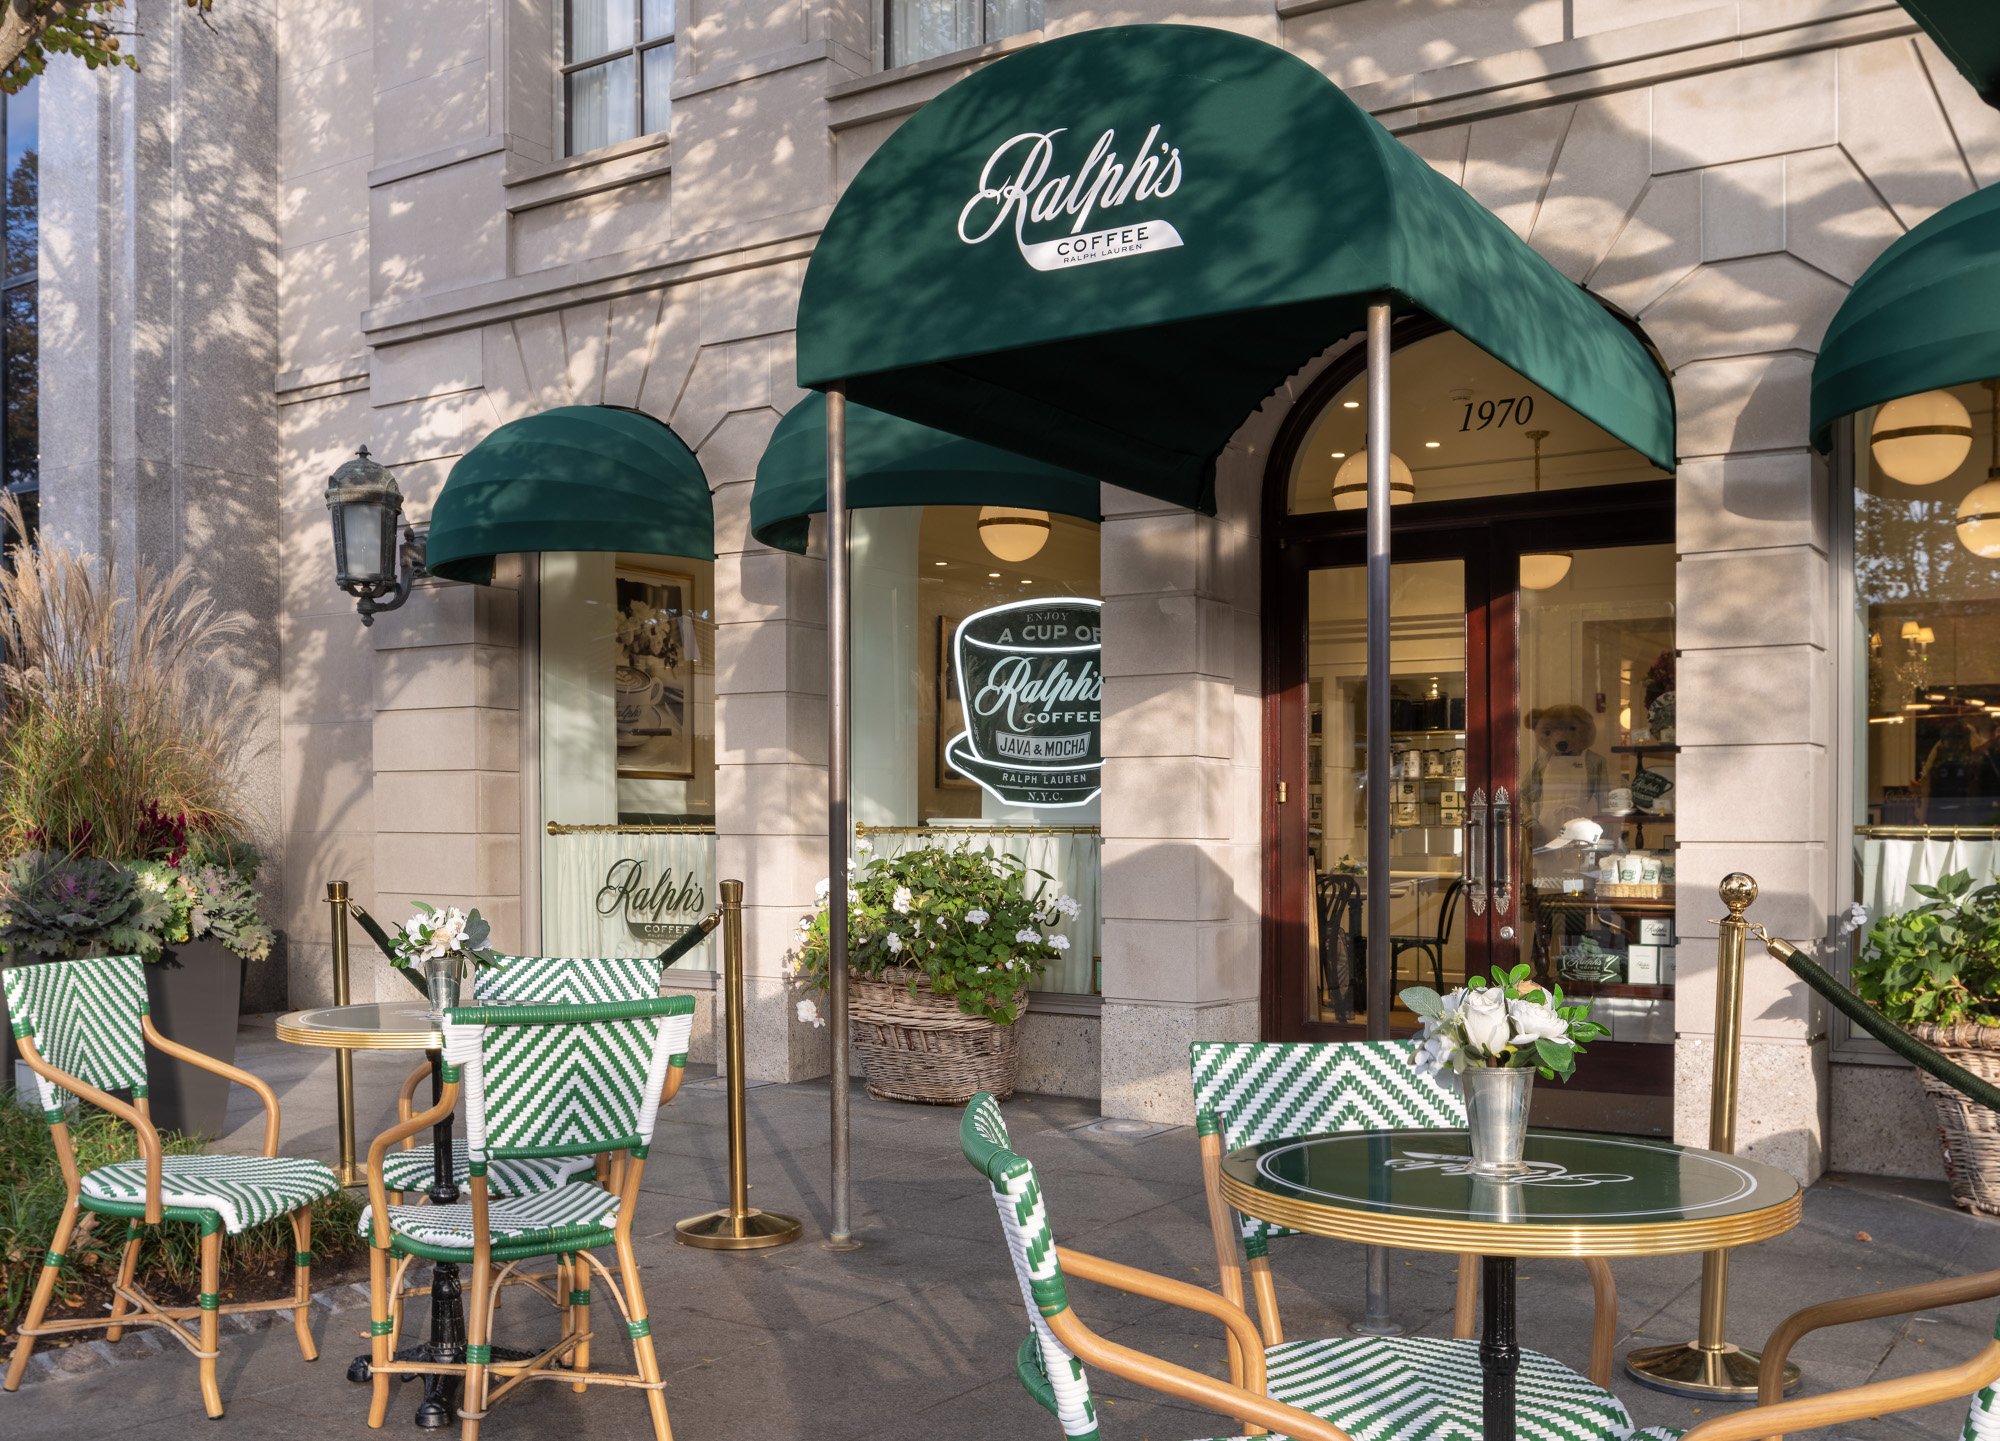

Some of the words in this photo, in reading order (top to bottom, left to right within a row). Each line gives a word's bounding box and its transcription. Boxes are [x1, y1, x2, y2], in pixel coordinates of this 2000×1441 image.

[957, 123, 1183, 248] Ralph's
[1057, 226, 1149, 256] COFFEE
[1063, 252, 1097, 264] RALPH
[1101, 243, 1143, 257] LAUREN
[1458, 395, 1534, 433] 1970
[1026, 611, 1069, 623] ENJOY
[996, 627, 1014, 645] A
[1022, 624, 1069, 642] CUP
[1074, 625, 1102, 643] OF
[974, 656, 1104, 733] Ralph's
[1023, 711, 1101, 724] COFFEE
[1000, 737, 1031, 756] JAVA
[1033, 744, 1042, 756] &
[1044, 738, 1086, 757] MOCHA
[1002, 772, 1038, 784] RALPH
[1043, 773, 1087, 785] LAUREN
[1027, 792, 1064, 801] N.Y.C.
[595, 858, 705, 922] Ralph's
[644, 924, 690, 935] COFFEE
